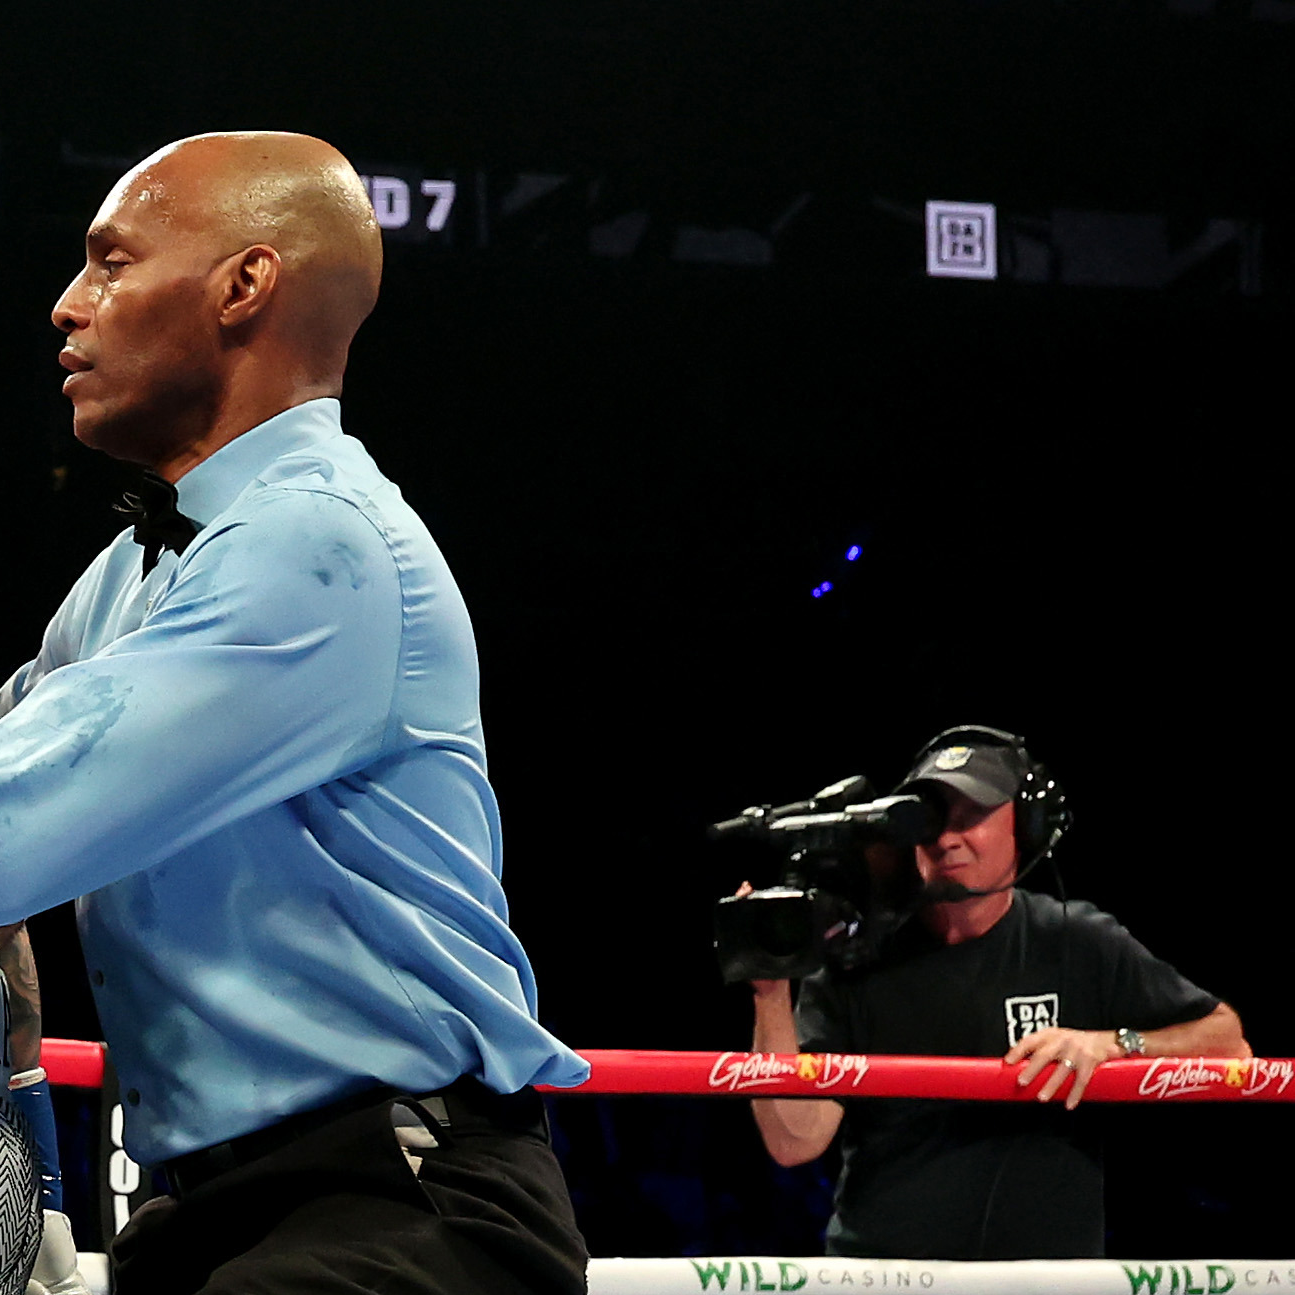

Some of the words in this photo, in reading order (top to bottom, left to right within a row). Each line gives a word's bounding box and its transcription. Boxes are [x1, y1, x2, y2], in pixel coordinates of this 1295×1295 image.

[421, 179, 456, 232] 7
[1019, 1003, 1050, 1021] DA
[708, 1051, 795, 1091] Golden
[815, 1053, 870, 1089] Boy
[1138, 1056, 1228, 1099] Golden
[1241, 1057, 1294, 1096] Boy
[690, 1259, 808, 1292] WILD
[817, 1268, 935, 1288] CASINO
[1121, 1264, 1236, 1295] WILD
